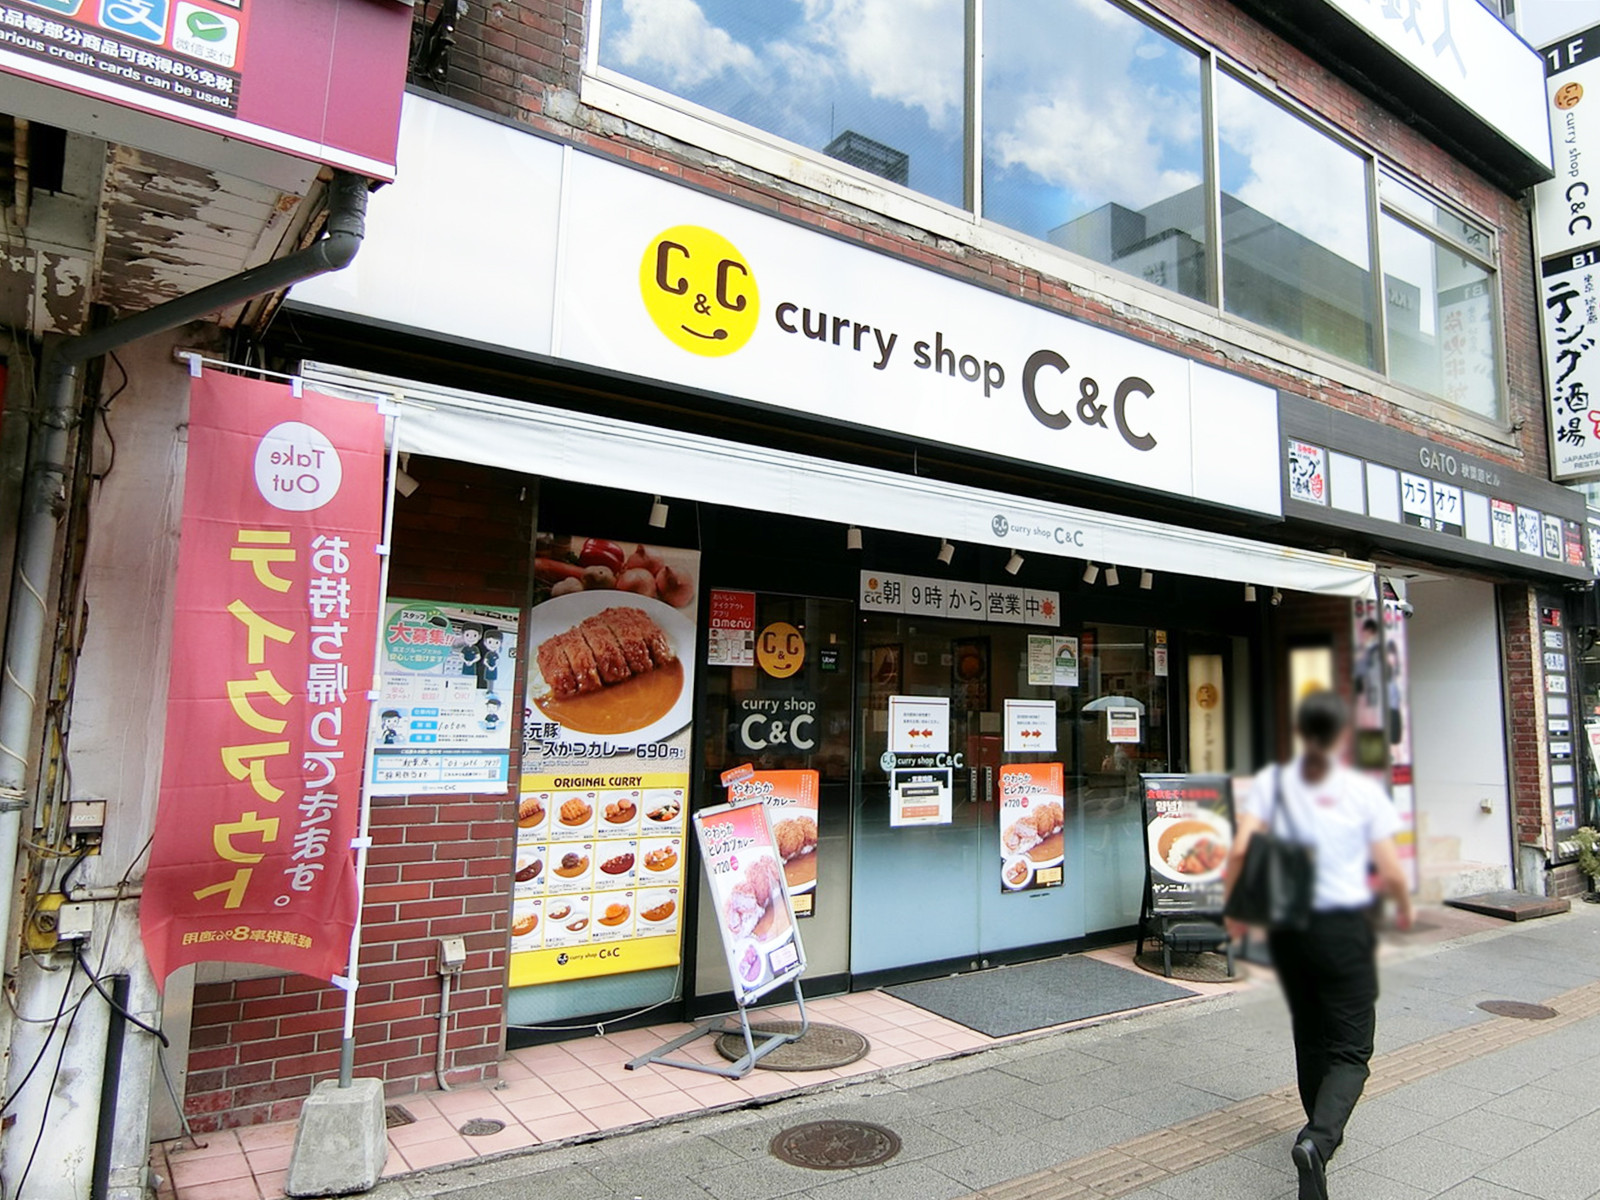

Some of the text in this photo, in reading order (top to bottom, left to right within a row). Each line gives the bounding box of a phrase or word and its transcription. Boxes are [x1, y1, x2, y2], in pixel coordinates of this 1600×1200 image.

[175, 37, 233, 66] 微信支付
[1548, 38, 1584, 70] 1F
[49, 42, 96, 67] credit
[99, 59, 141, 81] cards
[144, 73, 171, 90] can
[174, 81, 192, 96] be
[196, 89, 233, 109] used.
[1565, 112, 1592, 236] curry shop C&C
[1571, 252, 1595, 269] B1
[775, 302, 1157, 451] curry shop C&C
[1546, 281, 1595, 447] テング酒場
[1419, 447, 1456, 476] GATO
[1403, 478, 1458, 514] カラオケ
[1011, 524, 1083, 547] curry shop C&C
[403, 612, 426, 621] スタッフ
[742, 697, 816, 714] curry shop
[741, 713, 814, 750] C&C
[897, 753, 964, 768] curry shop C&C
[554, 777, 642, 788] ORIGINAL CURRY
[733, 781, 774, 795] やわらか
[599, 948, 620, 960] C&C
